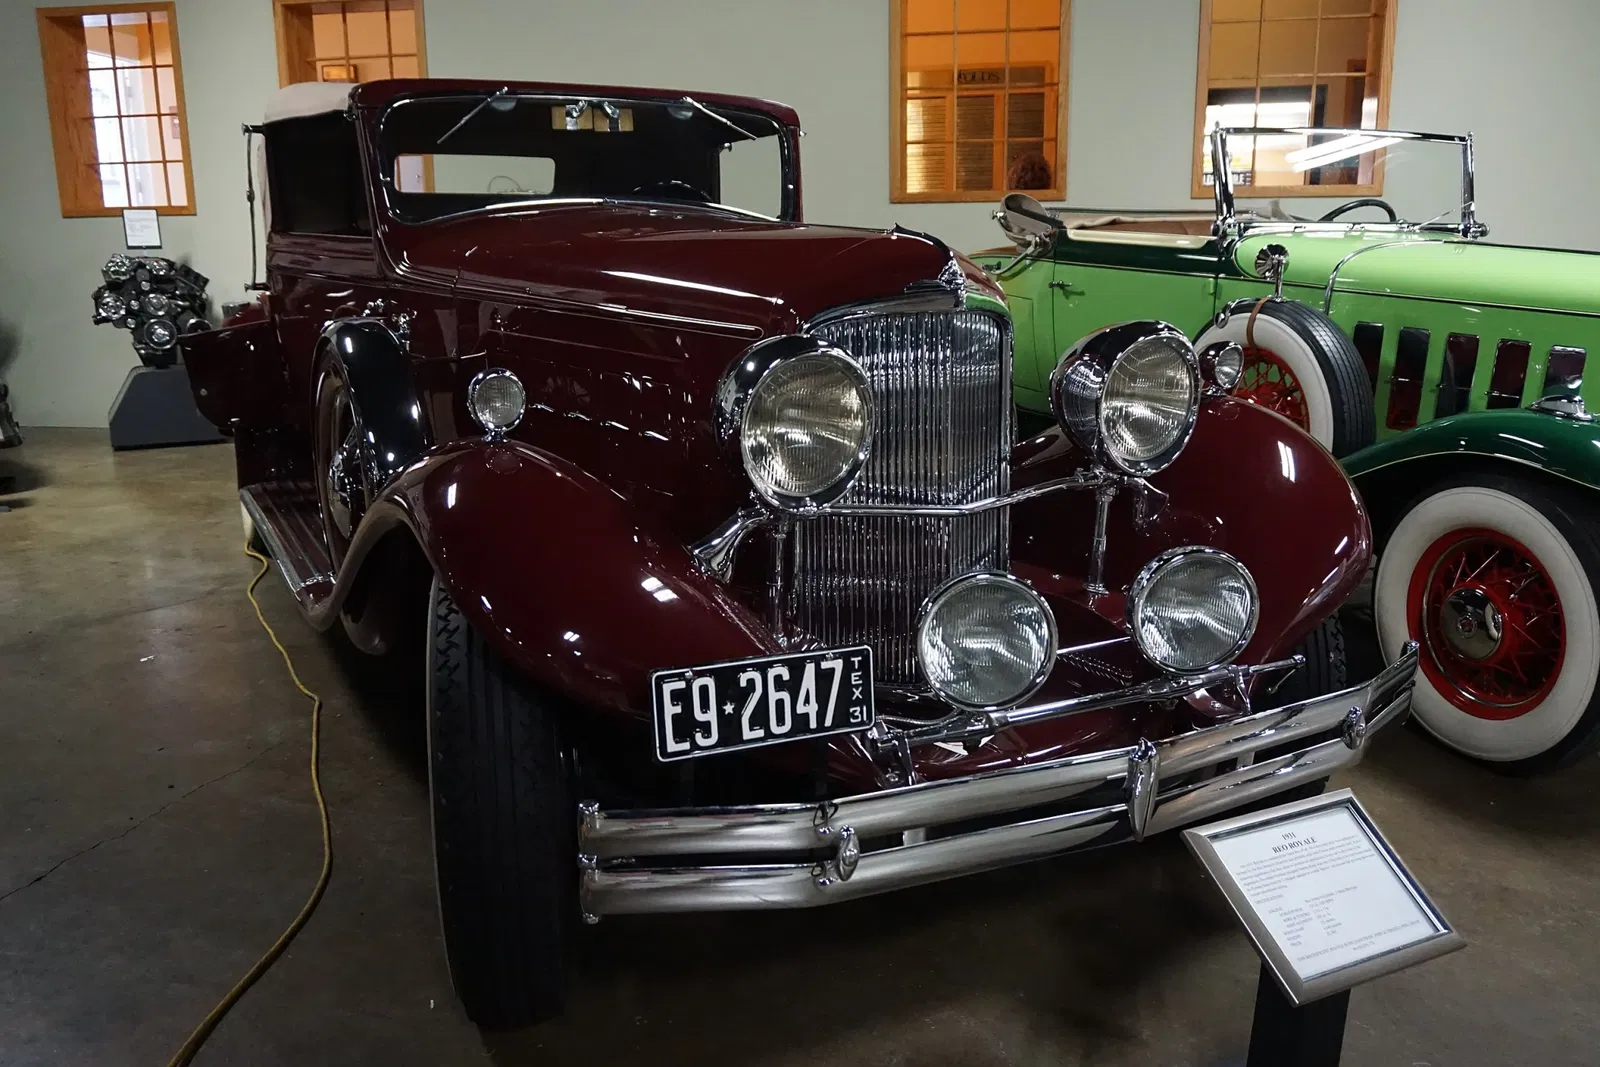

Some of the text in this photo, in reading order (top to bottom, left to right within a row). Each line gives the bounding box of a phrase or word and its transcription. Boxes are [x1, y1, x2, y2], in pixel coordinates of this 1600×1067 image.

[850, 656, 863, 700] TEX
[662, 658, 844, 753] E9 2647
[850, 705, 867, 723] 31
[1271, 837, 1318, 854] REO ROYALE
[1281, 832, 1297, 841] 1931
